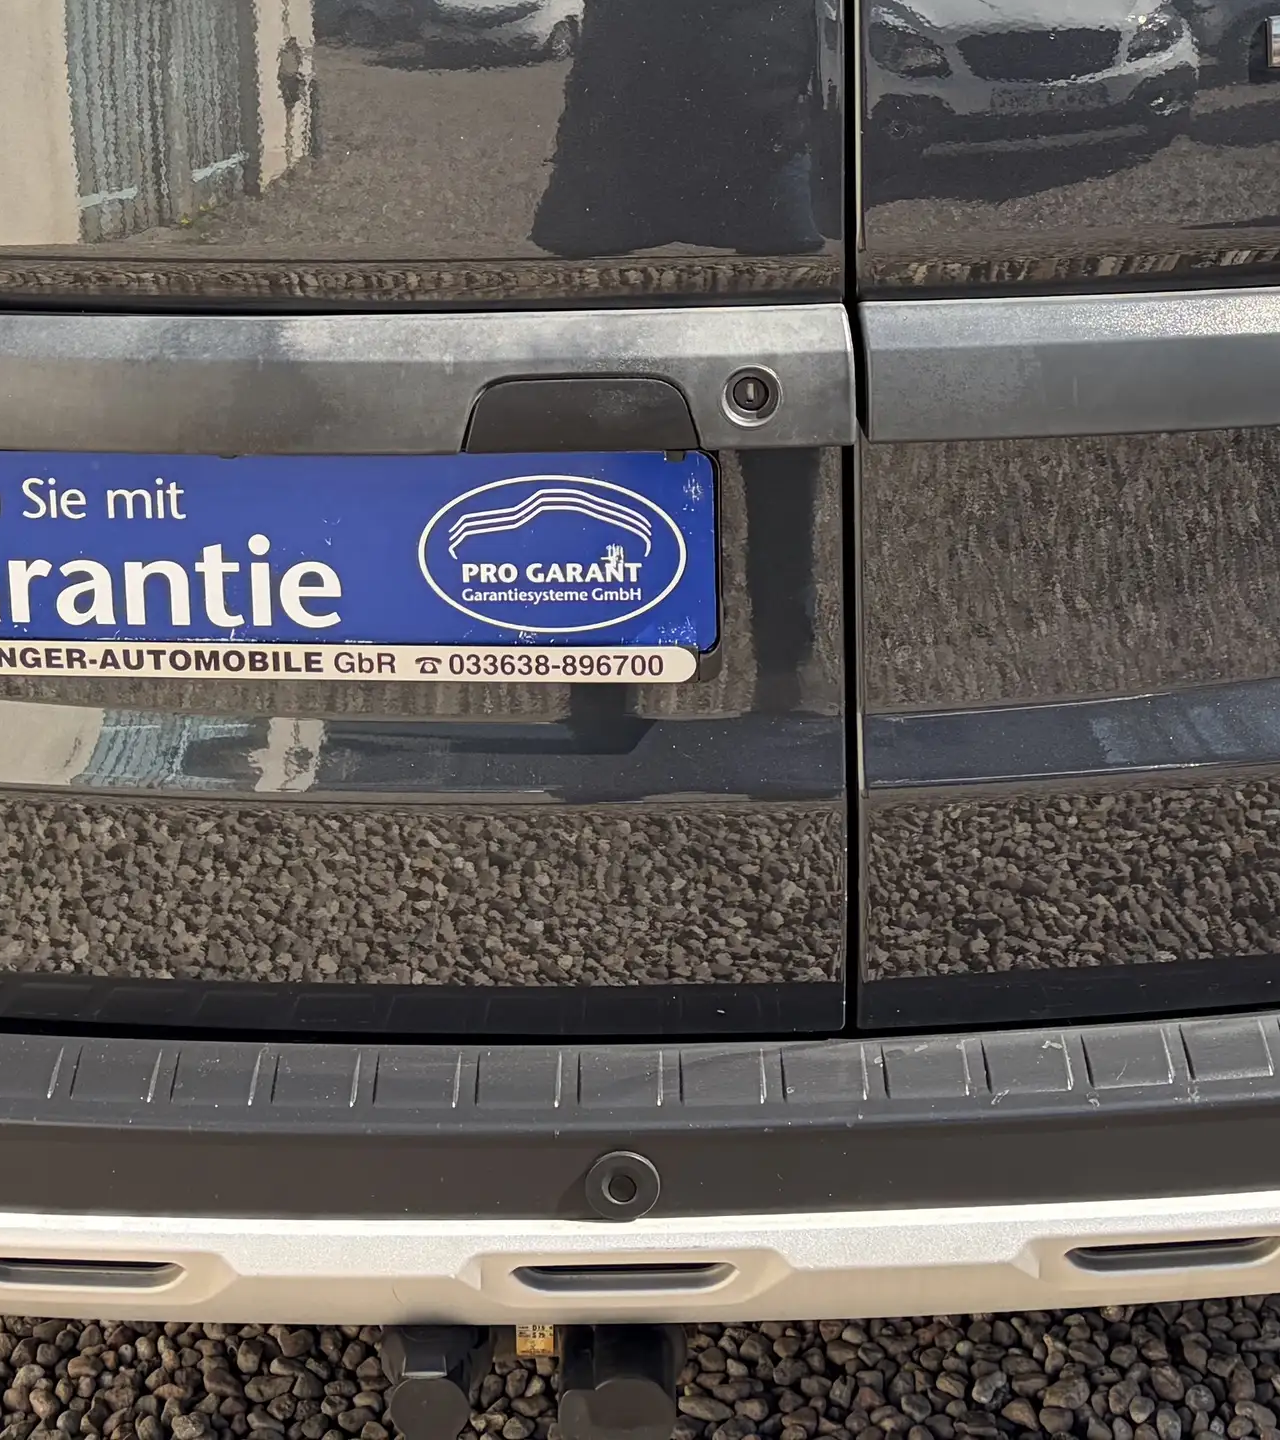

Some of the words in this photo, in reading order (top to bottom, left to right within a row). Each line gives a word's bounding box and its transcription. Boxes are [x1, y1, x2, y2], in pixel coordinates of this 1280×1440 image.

[22, 477, 86, 519] Sie
[106, 477, 187, 520] mit
[461, 562, 519, 583] PRO
[525, 562, 643, 584] GARANT
[461, 588, 589, 605] Garantiesysteme
[591, 587, 642, 602] GmbH
[333, 651, 397, 675] GbR
[448, 653, 665, 677] 033638-896700
